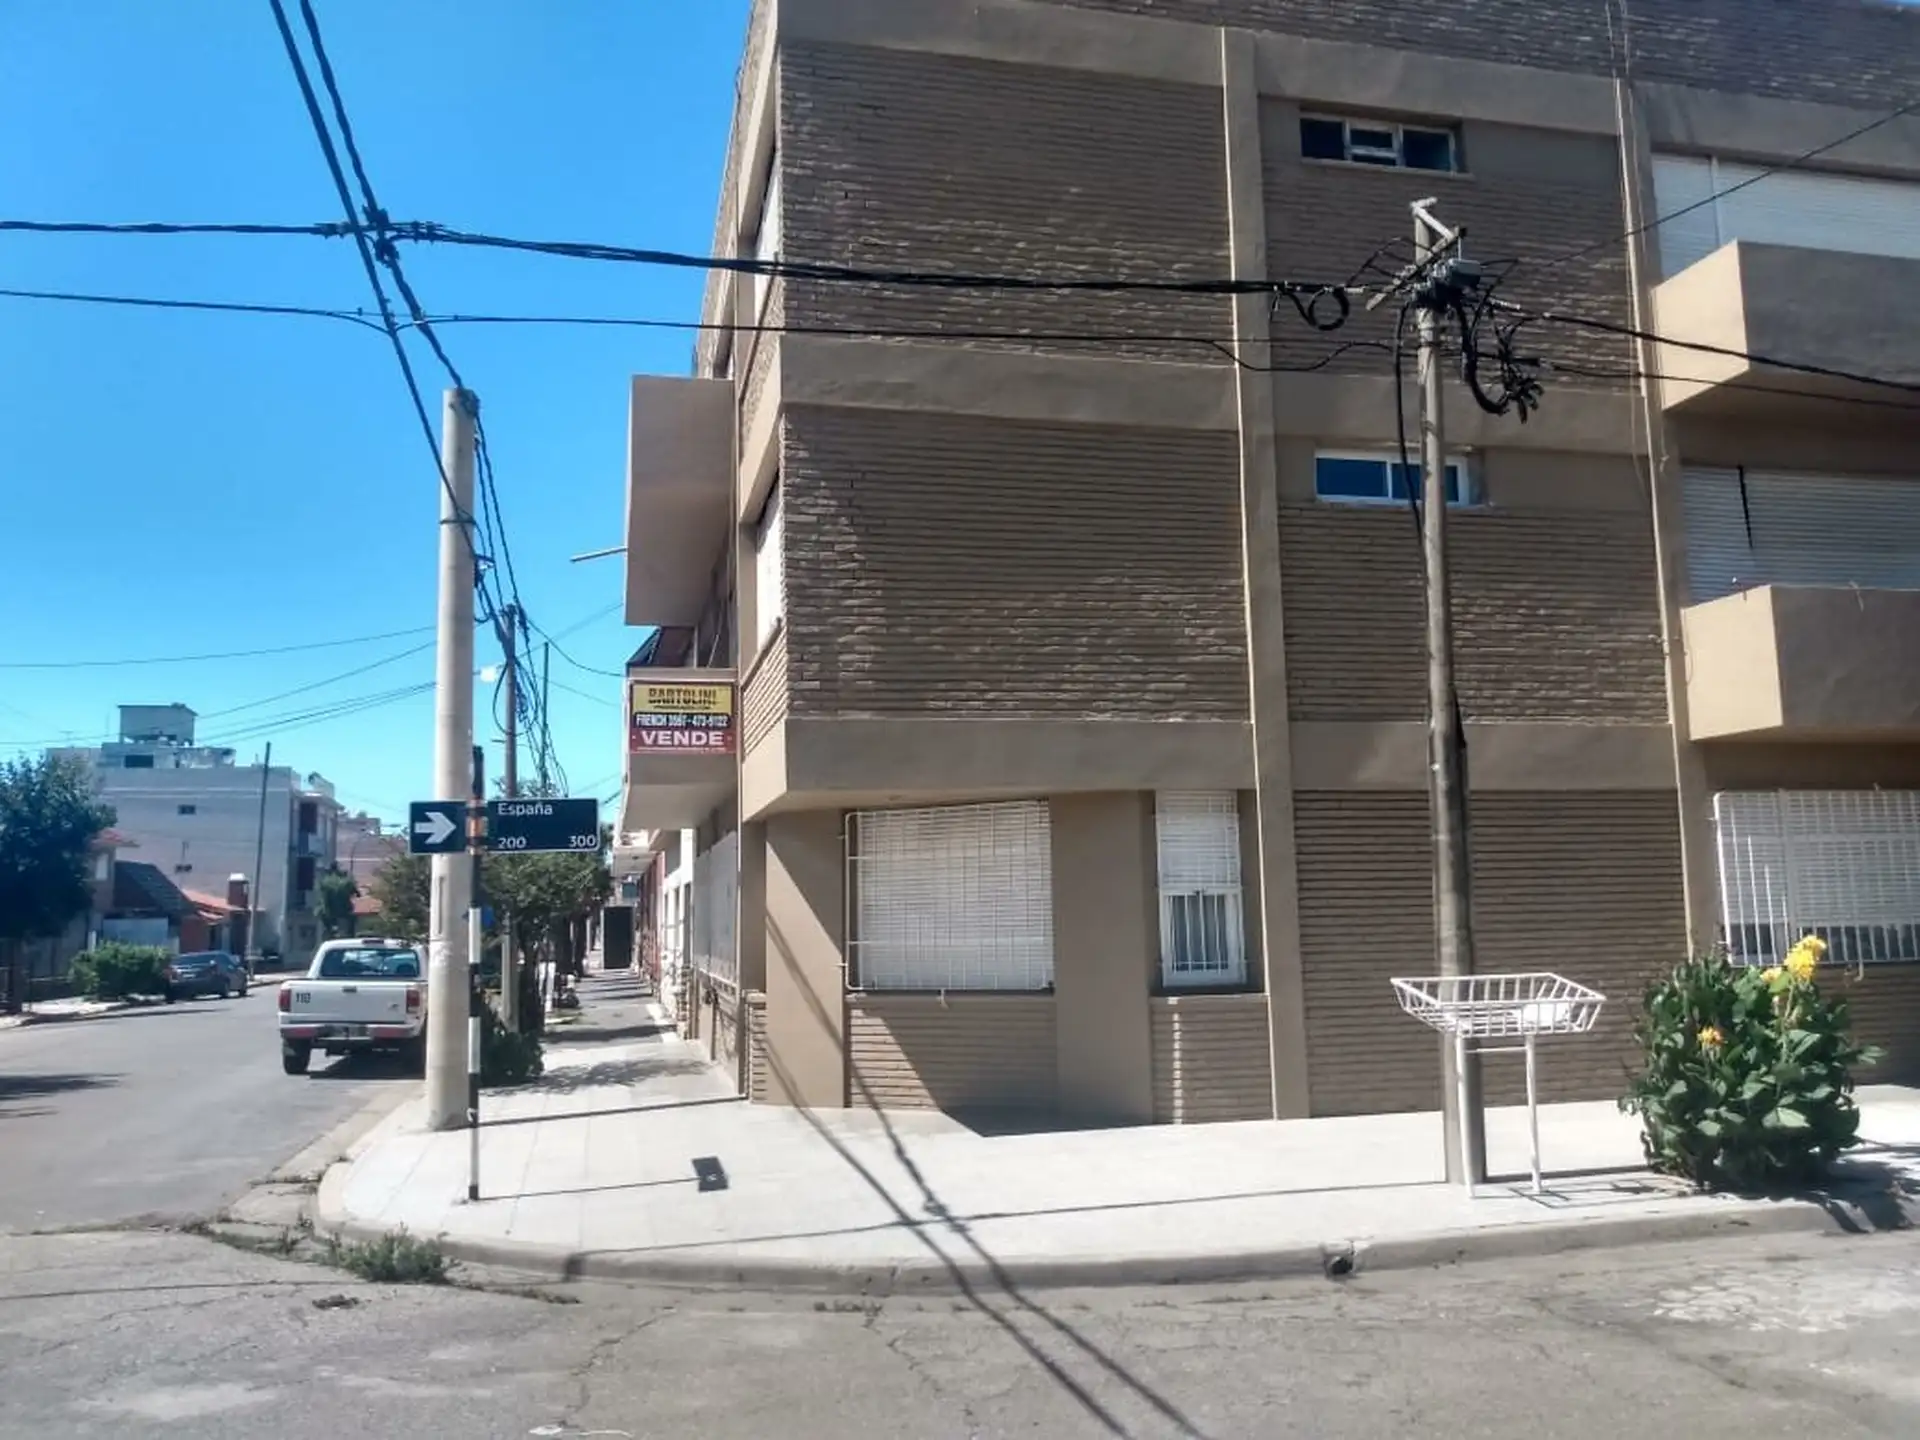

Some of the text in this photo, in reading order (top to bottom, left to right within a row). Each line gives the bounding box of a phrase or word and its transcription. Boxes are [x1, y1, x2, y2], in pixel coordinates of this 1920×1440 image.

[641, 730, 725, 746] VENDE
[497, 802, 553, 817] España
[498, 835, 597, 849] 200 300
